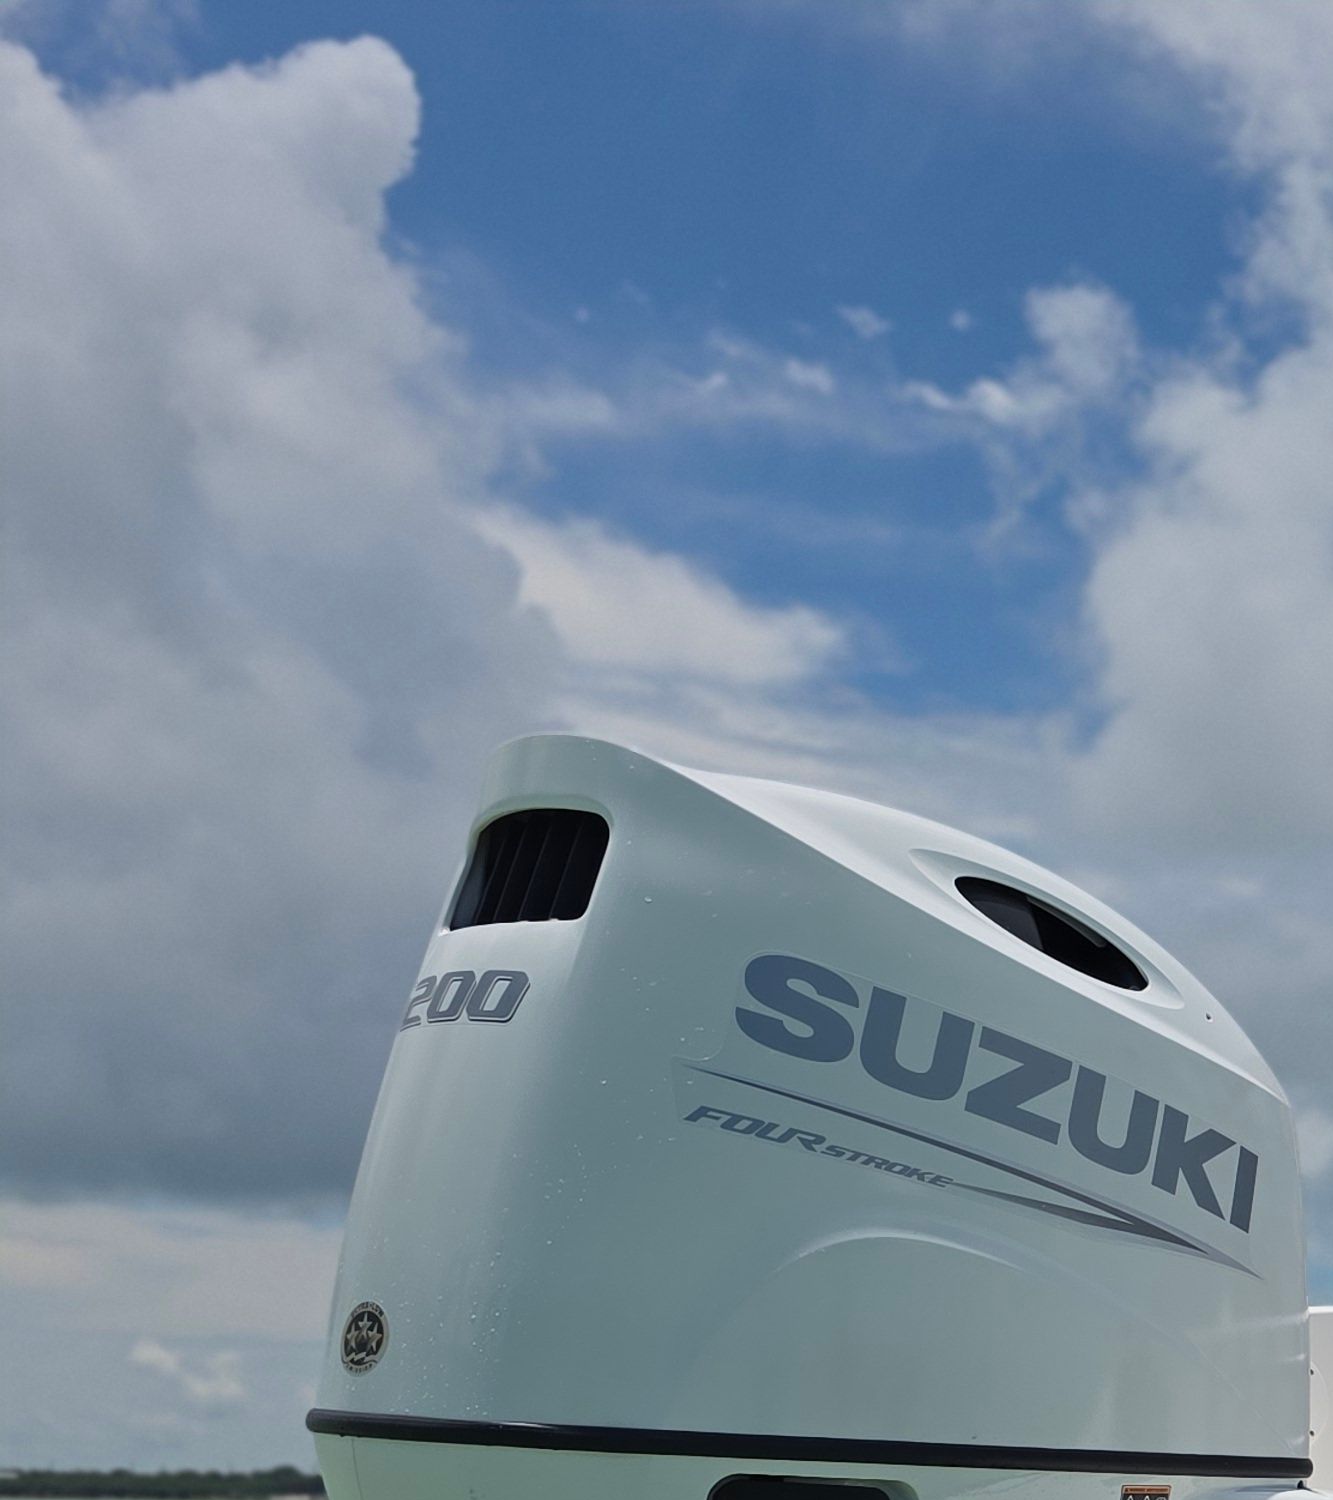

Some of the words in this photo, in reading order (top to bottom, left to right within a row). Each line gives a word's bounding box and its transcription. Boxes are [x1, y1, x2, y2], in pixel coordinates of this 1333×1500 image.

[400, 970, 531, 1032] 200
[735, 954, 1259, 1234] SUZUKI
[683, 1105, 826, 1152] FOUR
[820, 1144, 953, 1188] STROKE
